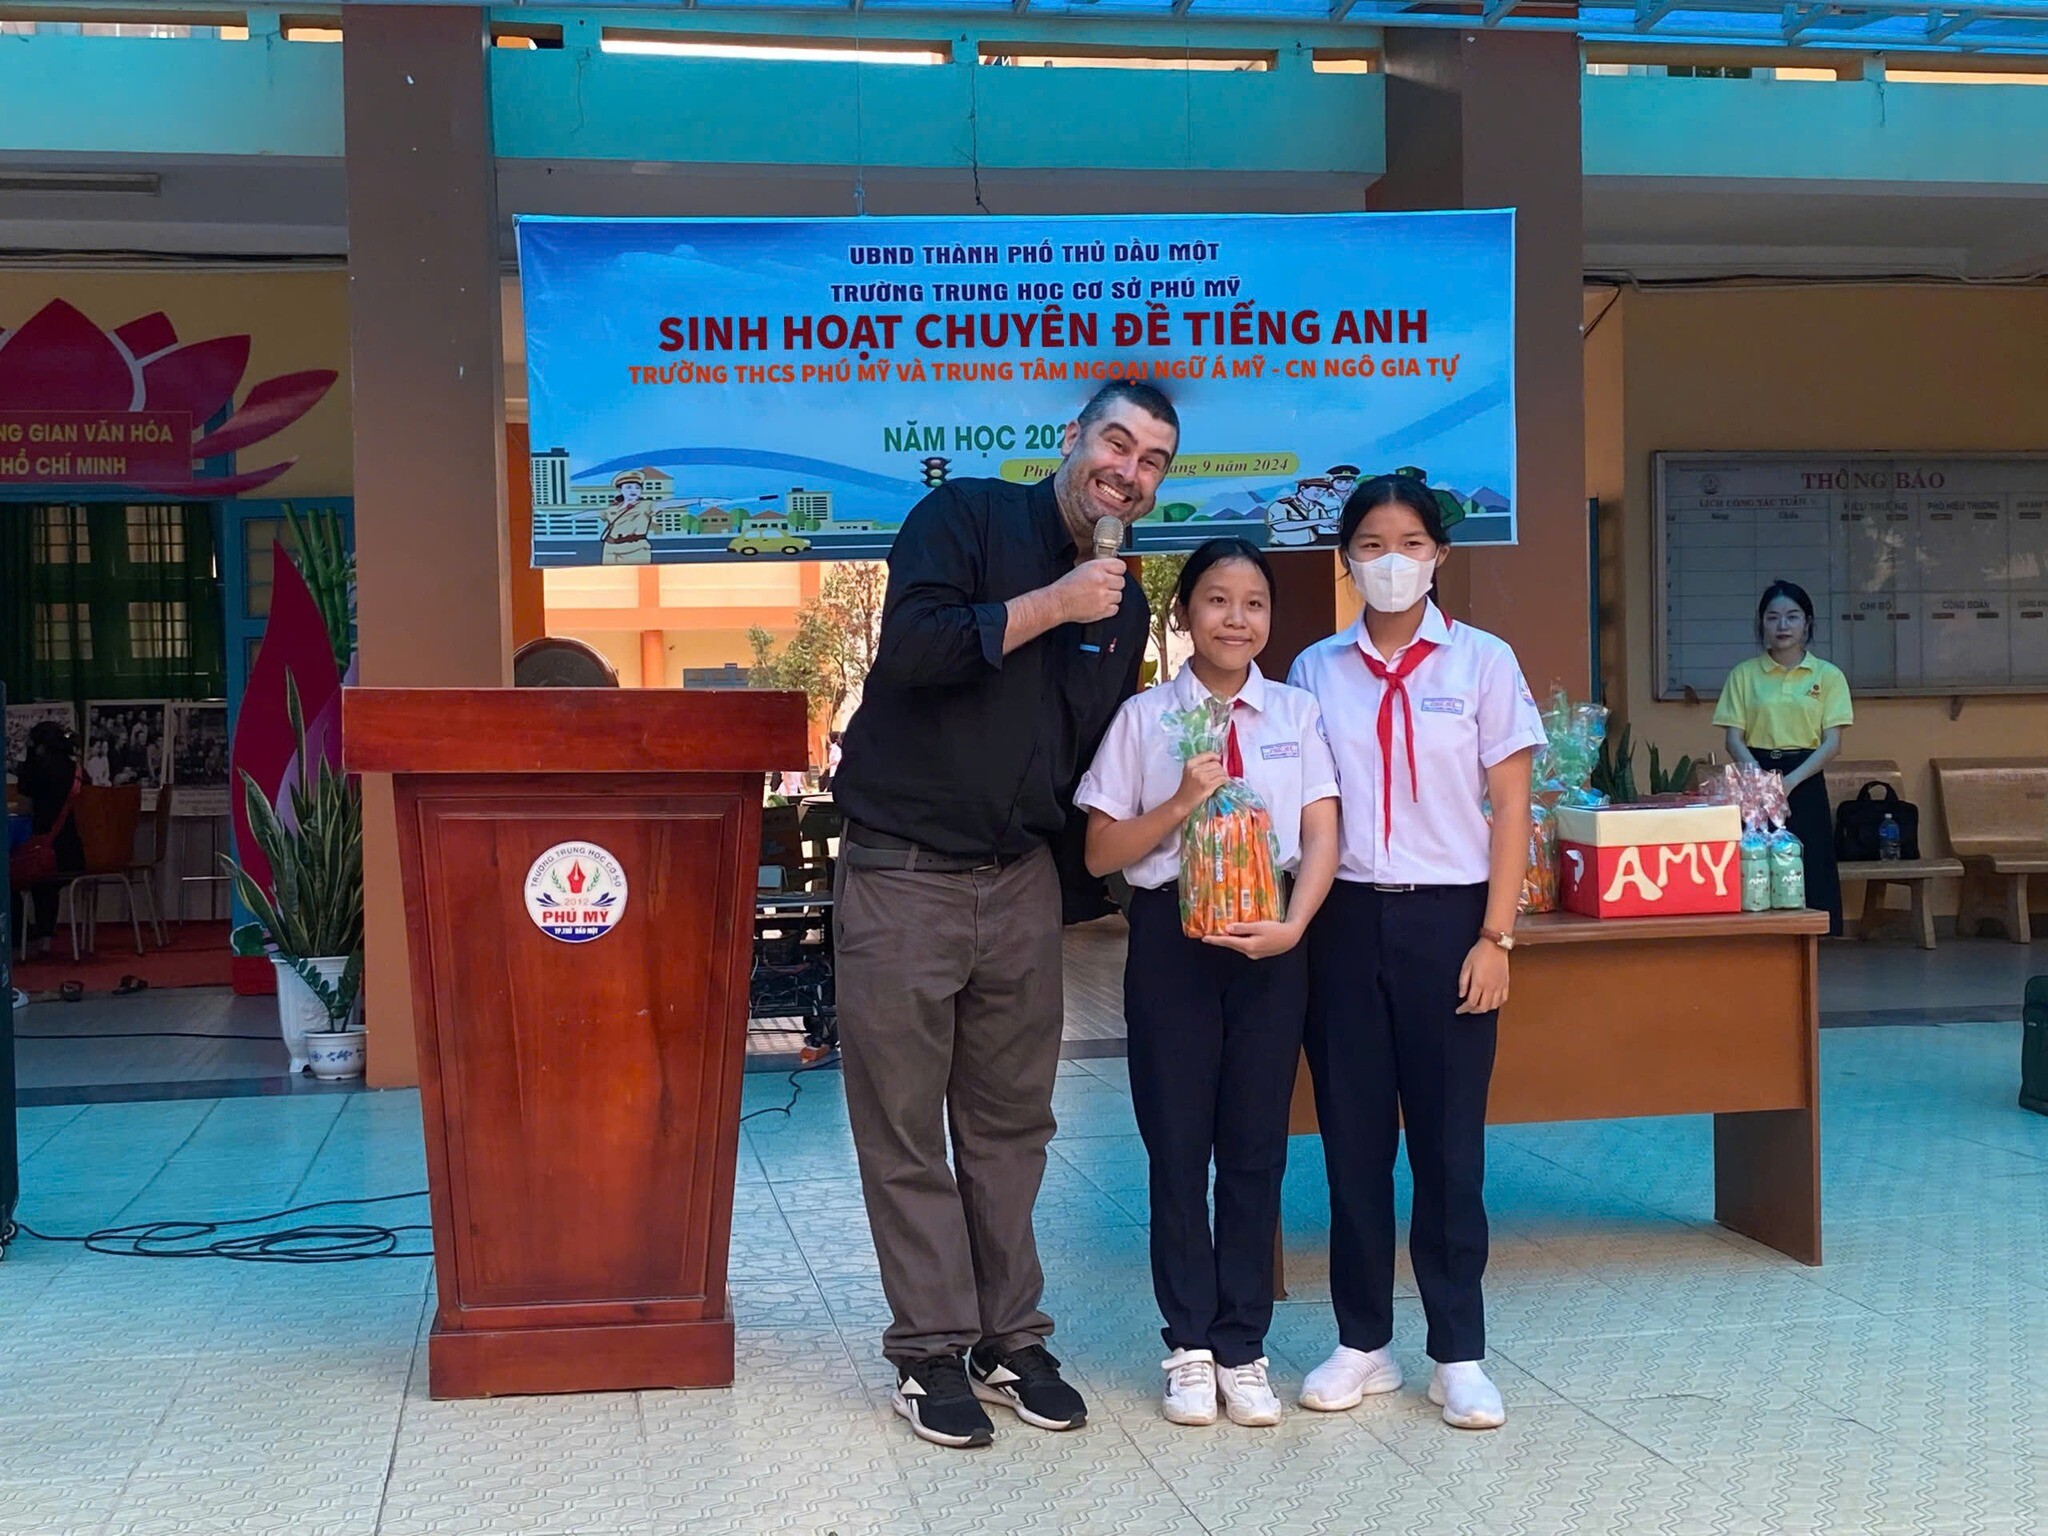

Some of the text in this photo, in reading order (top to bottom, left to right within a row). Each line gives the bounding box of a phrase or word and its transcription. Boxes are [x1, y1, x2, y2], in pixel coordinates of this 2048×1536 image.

[850, 238, 1219, 265] UBND THÀNH PHỐ THỦ DẦU MỘT
[831, 276, 1241, 304] TRƯỜNG TRUNG HỌC CƠ SỞ PHÚ MỸ
[658, 299, 1427, 361] SINH HOẠT CHUYÊN ĐỀ TIẾNG ANH
[628, 360, 727, 384] TRƯỜNG
[734, 363, 795, 383] THCS
[802, 358, 850, 383] PHÚ
[858, 358, 891, 382] MỸ
[896, 358, 927, 382] VÀ
[931, 362, 1013, 382] TRUNG
[1020, 358, 1067, 381] TÂM
[1074, 360, 1148, 386] NGOẠI
[1154, 355, 1206, 379] NGỮ
[1211, 355, 1227, 379] Á
[1233, 355, 1266, 378] MỸ
[1285, 360, 1316, 378] CN
[1324, 355, 1375, 377] NGÔ
[1381, 358, 1421, 377] GIA
[1426, 353, 1460, 382] TỰ
[29, 423, 78, 442] GIAN
[84, 420, 124, 442] VĂN
[130, 420, 173, 442] HÓA
[884, 420, 1067, 458] NĂM HỌC 202
[35, 452, 71, 475] CHÍ
[76, 456, 126, 475] MINH
[1169, 461, 1197, 476] áng
[1202, 460, 1211, 472] 9
[1215, 460, 1247, 472] năm
[1252, 458, 1289, 471] 2024
[1801, 467, 1945, 490] THÔNG BÁO
[1603, 841, 1737, 902] AMY
[542, 908, 577, 923] PHÚ
